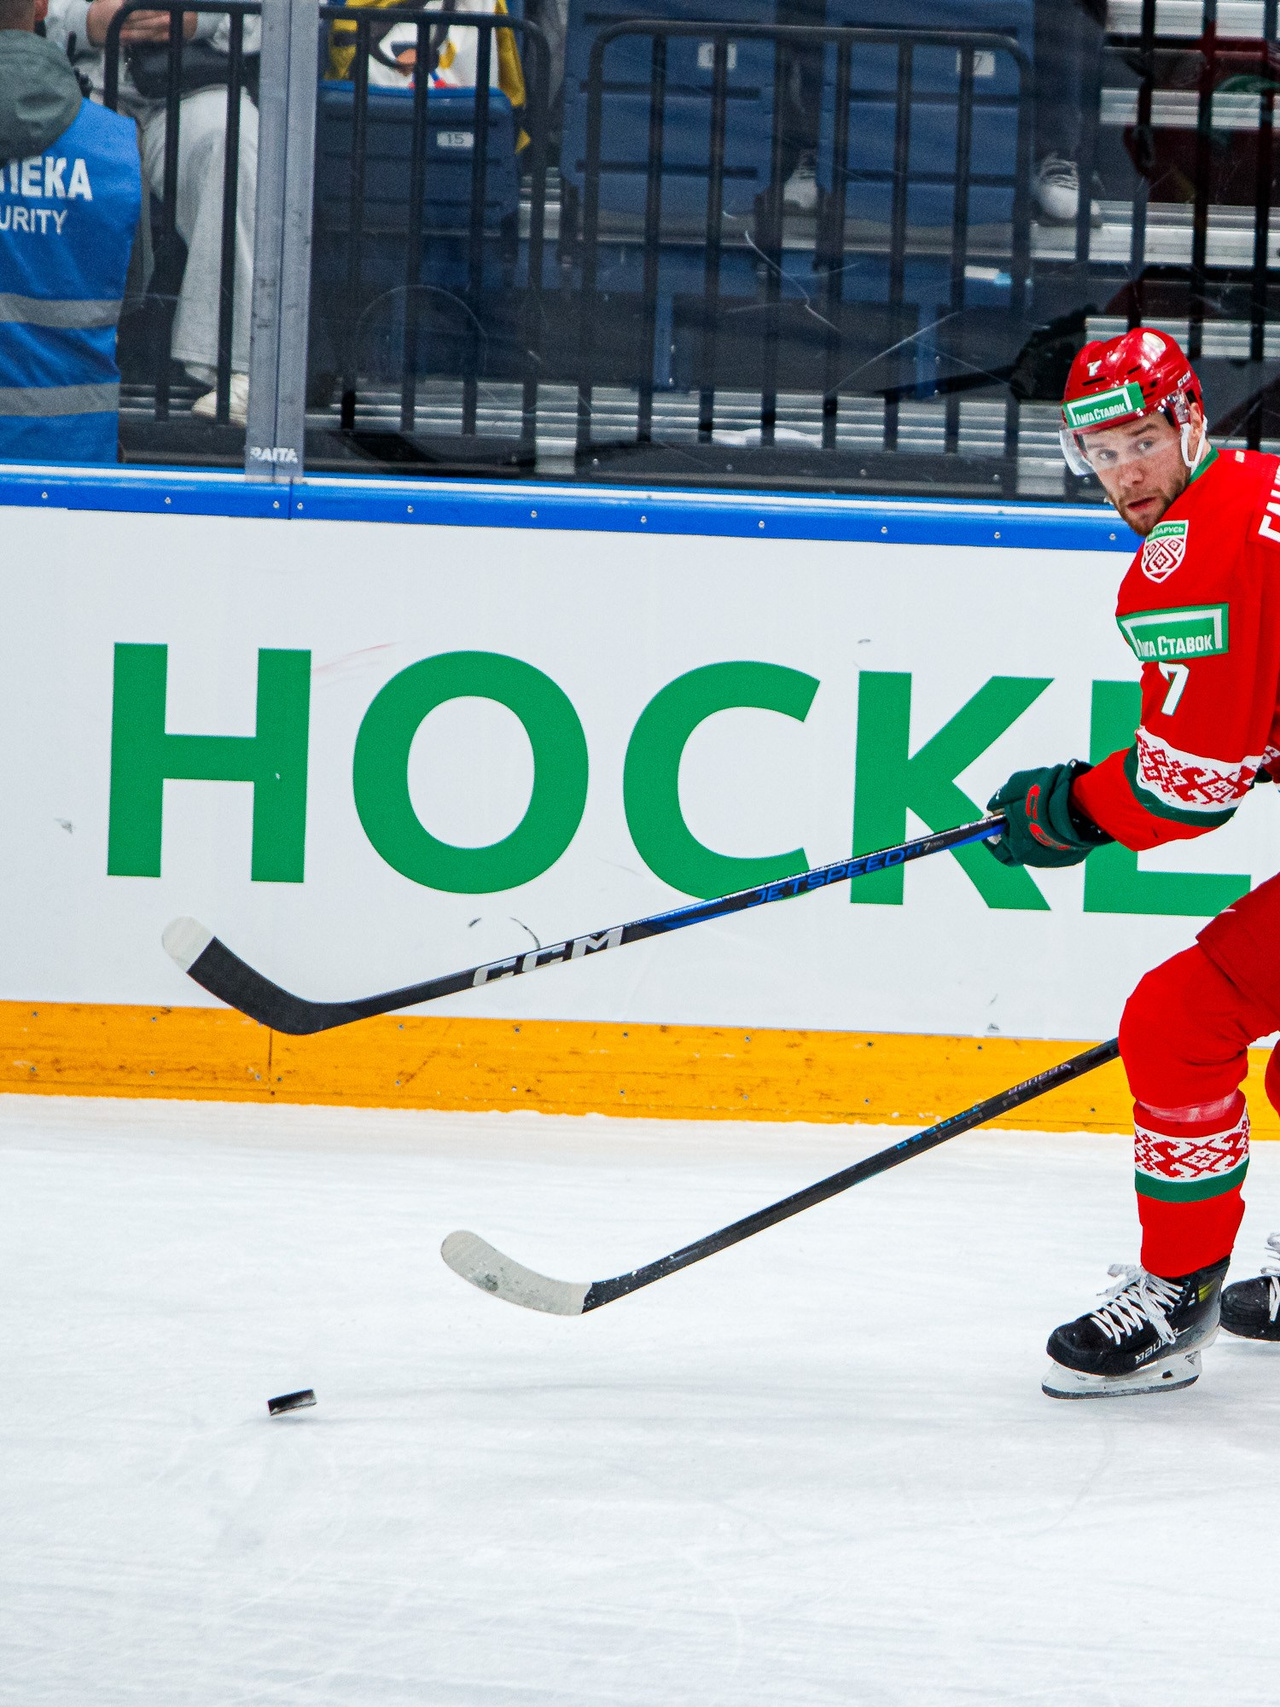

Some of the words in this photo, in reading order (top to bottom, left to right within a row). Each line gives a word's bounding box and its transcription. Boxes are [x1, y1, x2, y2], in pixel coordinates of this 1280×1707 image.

[447, 133, 464, 145] 15
[1158, 661, 1190, 716] 7
[747, 850, 905, 907] JETSPEED
[473, 926, 624, 987] CCM
